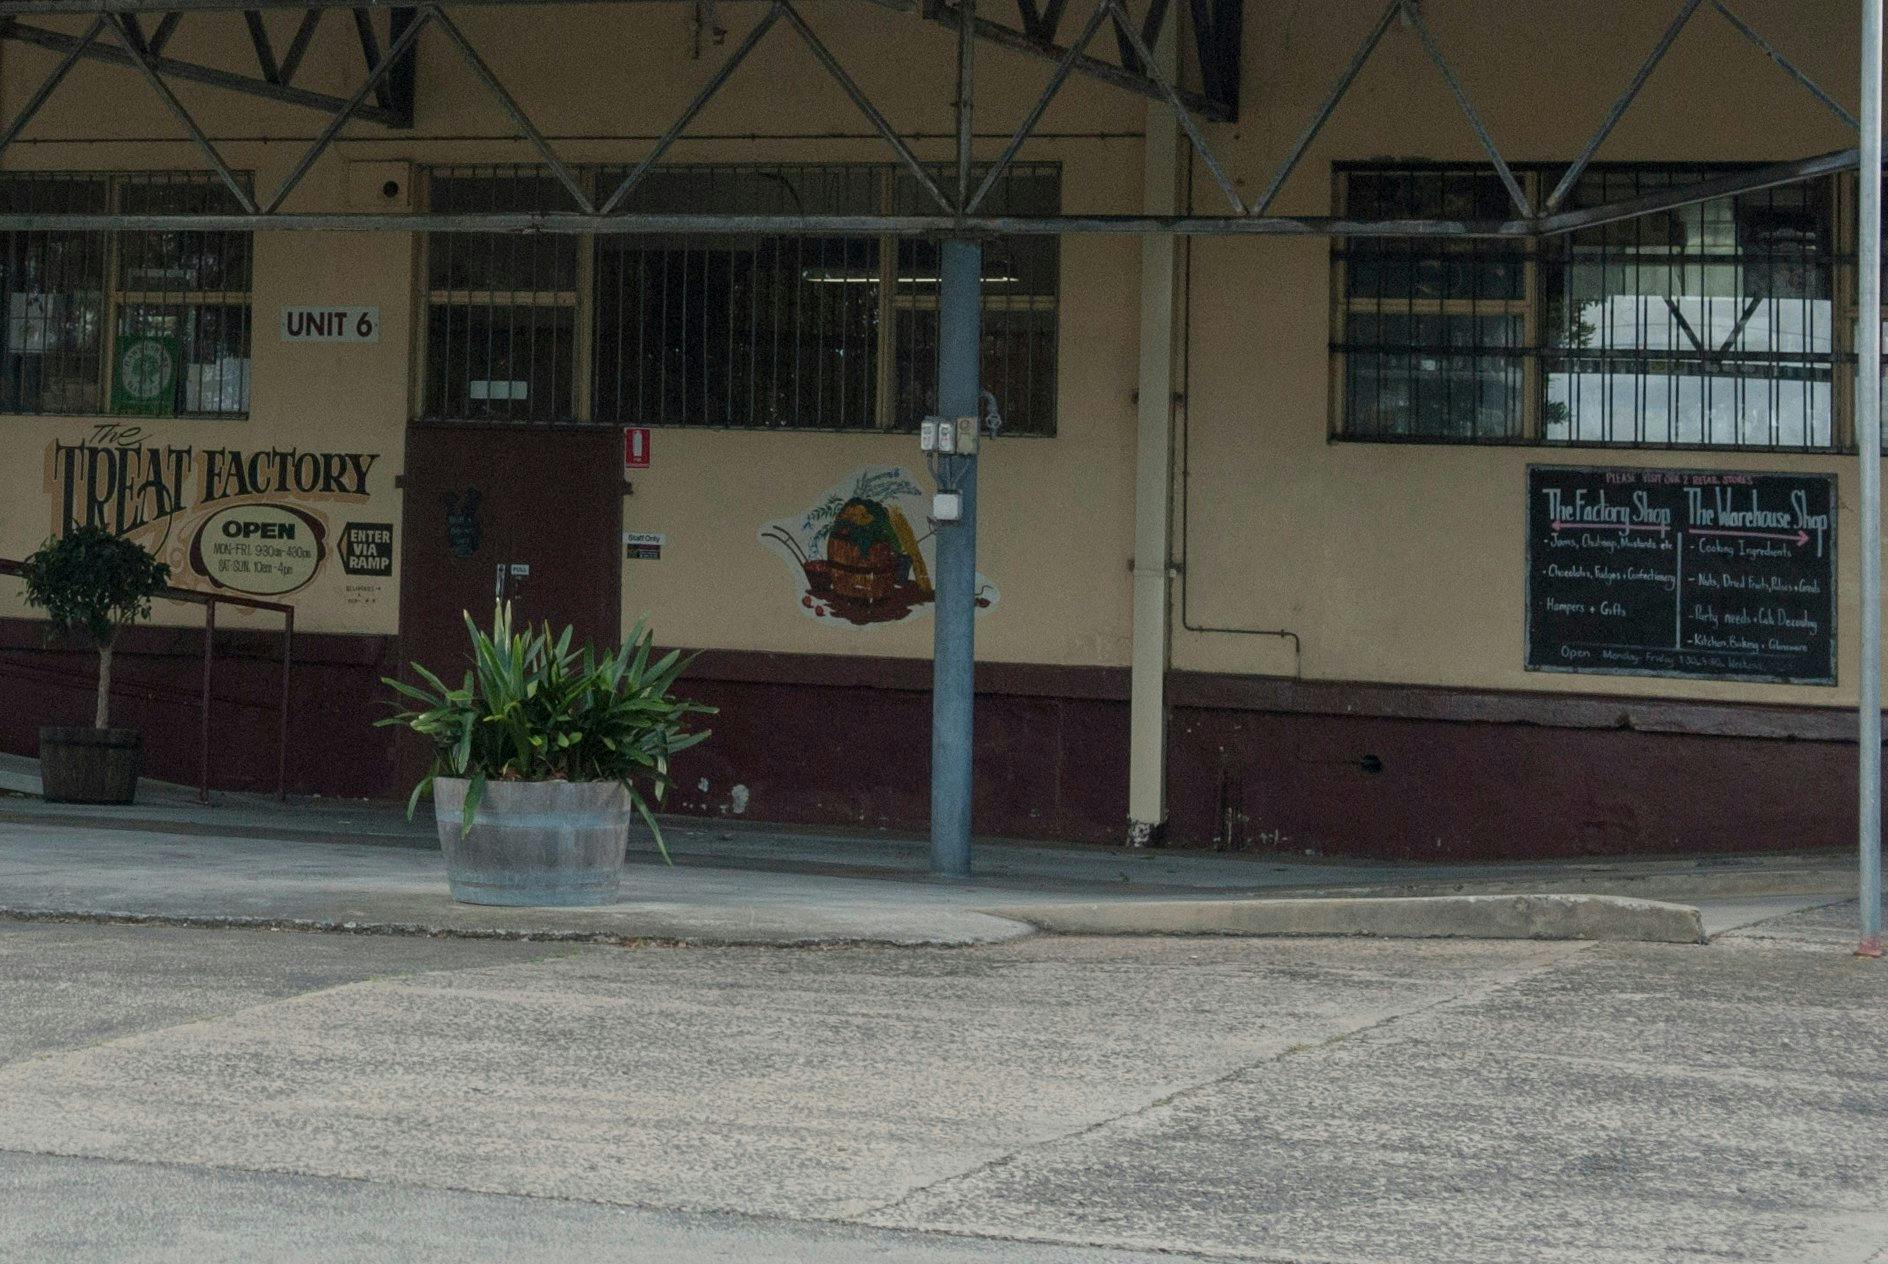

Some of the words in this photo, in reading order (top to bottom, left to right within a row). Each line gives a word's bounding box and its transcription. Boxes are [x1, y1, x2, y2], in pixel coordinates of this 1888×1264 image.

[287, 311, 348, 337] UNIT
[356, 311, 373, 338] 6
[87, 423, 154, 447] The
[54, 438, 193, 539] TREAT
[199, 445, 381, 505] FACTORY
[1542, 488, 1575, 522] The
[1575, 488, 1631, 537] Factory
[1632, 490, 1672, 539] Shop
[1683, 486, 1715, 526] The
[1714, 486, 1792, 529] Warehouse
[1791, 489, 1828, 558] Shop
[222, 519, 296, 540] OPEN
[350, 529, 390, 543] ENTER
[353, 543, 378, 556] VIA
[349, 556, 390, 570] RAMP
[1547, 597, 1585, 615] Hampers
[1600, 601, 1627, 617] Gifts
[1561, 645, 1591, 660] Open
